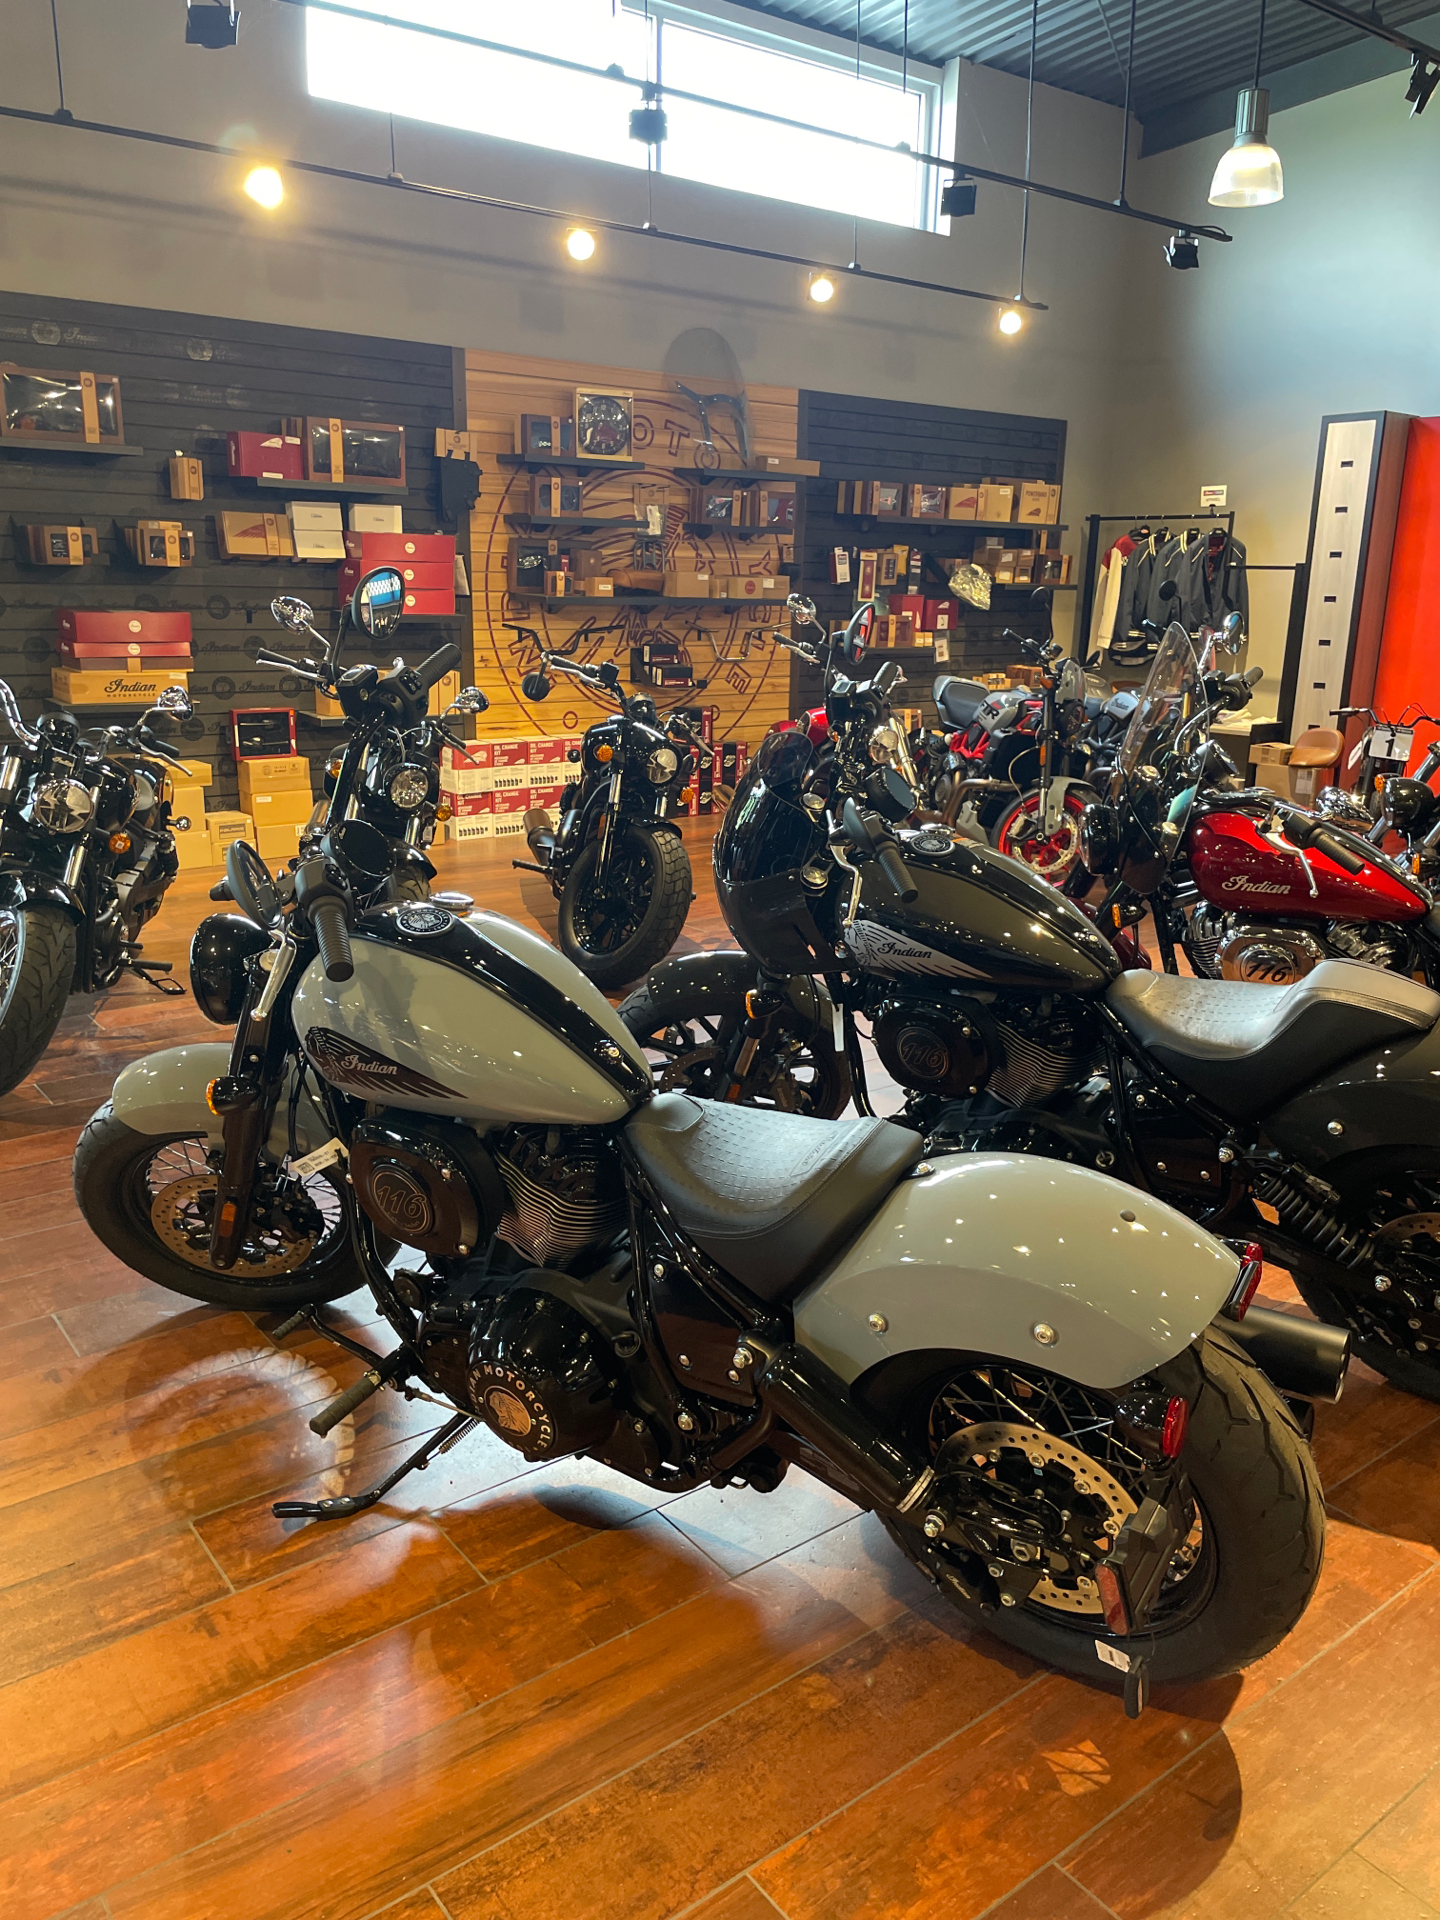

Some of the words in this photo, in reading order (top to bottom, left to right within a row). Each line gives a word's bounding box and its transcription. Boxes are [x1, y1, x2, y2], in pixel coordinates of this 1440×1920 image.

[104, 678, 157, 693] Indian
[238, 680, 276, 691] Indian
[1385, 738, 1395, 757] 1
[220, 825, 245, 833] POLARIS
[1221, 875, 1291, 894] Indian
[877, 942, 932, 959] Indian
[1246, 964, 1292, 982] 116
[341, 1054, 398, 1075] Indian
[902, 1042, 948, 1068] 116
[377, 1185, 427, 1219] 116
[483, 1364, 551, 1449] MOTORCYCLE
